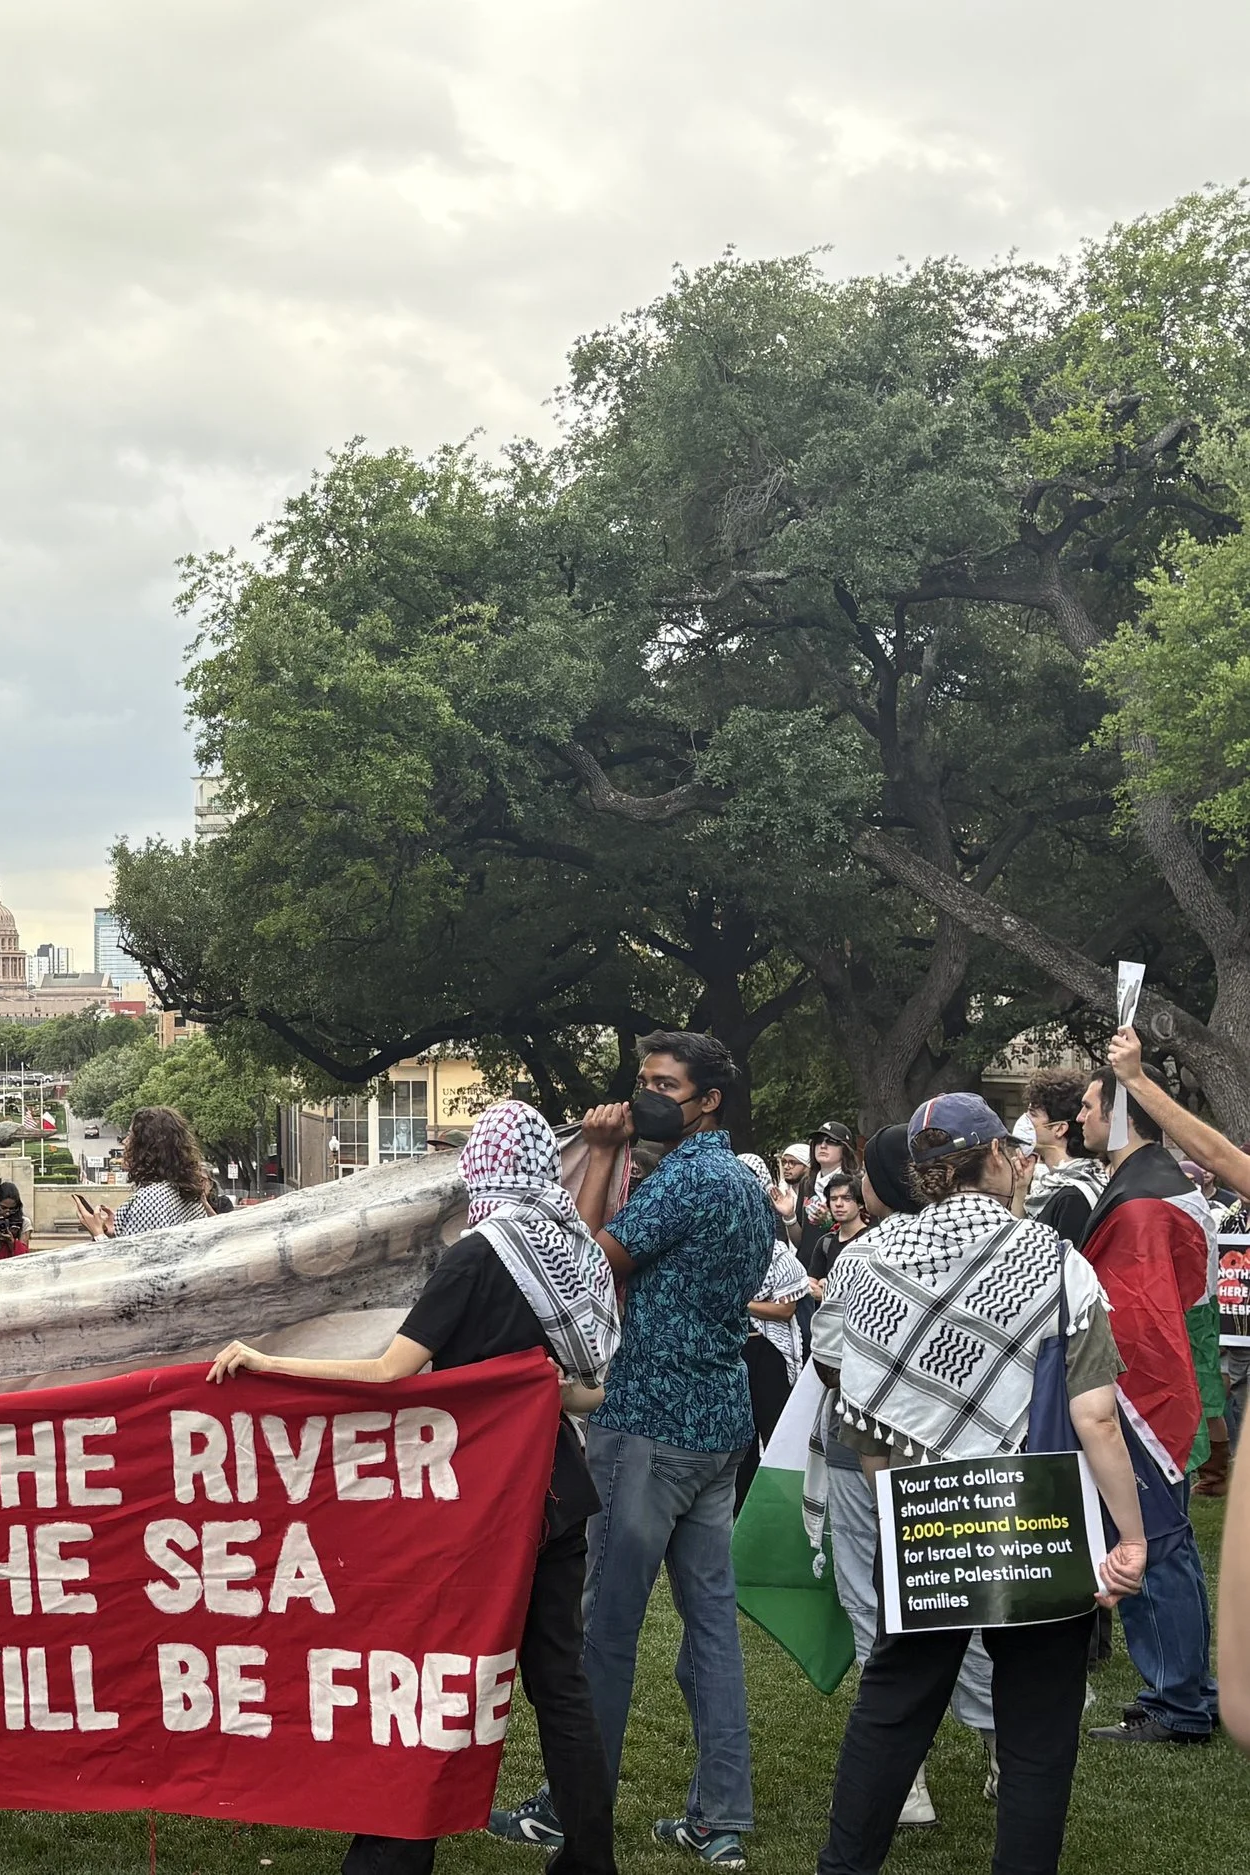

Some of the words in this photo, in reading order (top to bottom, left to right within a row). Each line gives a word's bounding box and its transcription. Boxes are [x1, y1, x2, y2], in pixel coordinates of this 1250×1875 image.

[1217, 1267, 1250, 1280] NOTH
[1219, 1285, 1249, 1298] HERE
[169, 1405, 460, 1505] RIVER
[898, 1478, 930, 1494] Your
[934, 1475, 959, 1490] tax
[962, 1469, 1025, 1487] dollars
[900, 1495, 970, 1518] shouldn't
[973, 1492, 1016, 1510] fund
[902, 1516, 1011, 1542] 2,000-pound
[1014, 1514, 1070, 1531] bombs
[903, 1548, 924, 1565] for
[927, 1542, 972, 1561] Israel
[976, 1543, 995, 1558] to
[1000, 1540, 1043, 1559] wipe
[1047, 1538, 1073, 1554] out
[143, 1518, 337, 1617] SEA
[905, 1570, 951, 1588] entire
[954, 1564, 1052, 1583] Palestinian
[907, 1594, 969, 1612] families
[157, 1642, 273, 1740] BE
[307, 1647, 517, 1753] FREE
